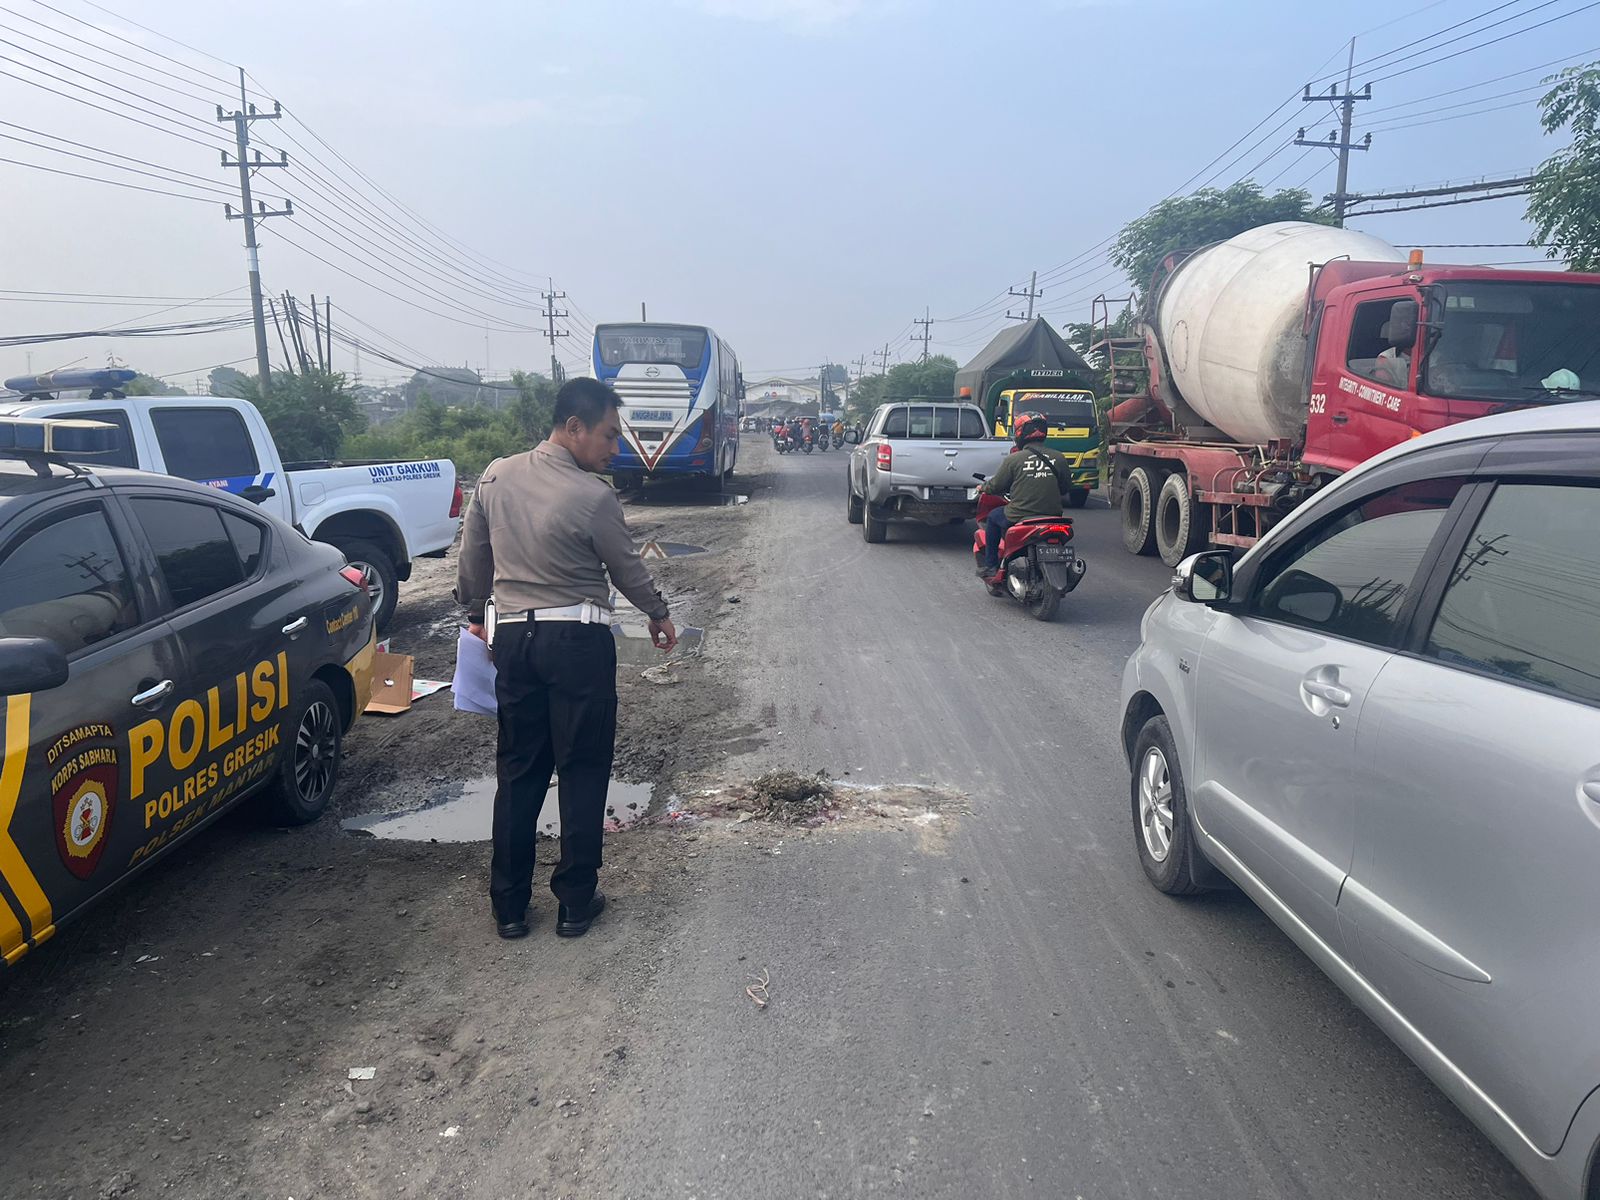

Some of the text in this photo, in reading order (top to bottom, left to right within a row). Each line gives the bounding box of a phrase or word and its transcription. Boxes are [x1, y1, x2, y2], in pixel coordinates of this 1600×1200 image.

[1310, 394, 1326, 413] 532
[1387, 396, 1401, 412] CARE
[368, 462, 440, 477] UNIT GAKKUM
[371, 475, 402, 484] SATLANTAS
[47, 724, 113, 764] DITSAMAPTA
[128, 651, 289, 800] POLISI
[51, 748, 117, 795] KORPS SABHARA
[145, 723, 280, 829] POLRES GRESIK
[208, 752, 275, 810] MANYAR
